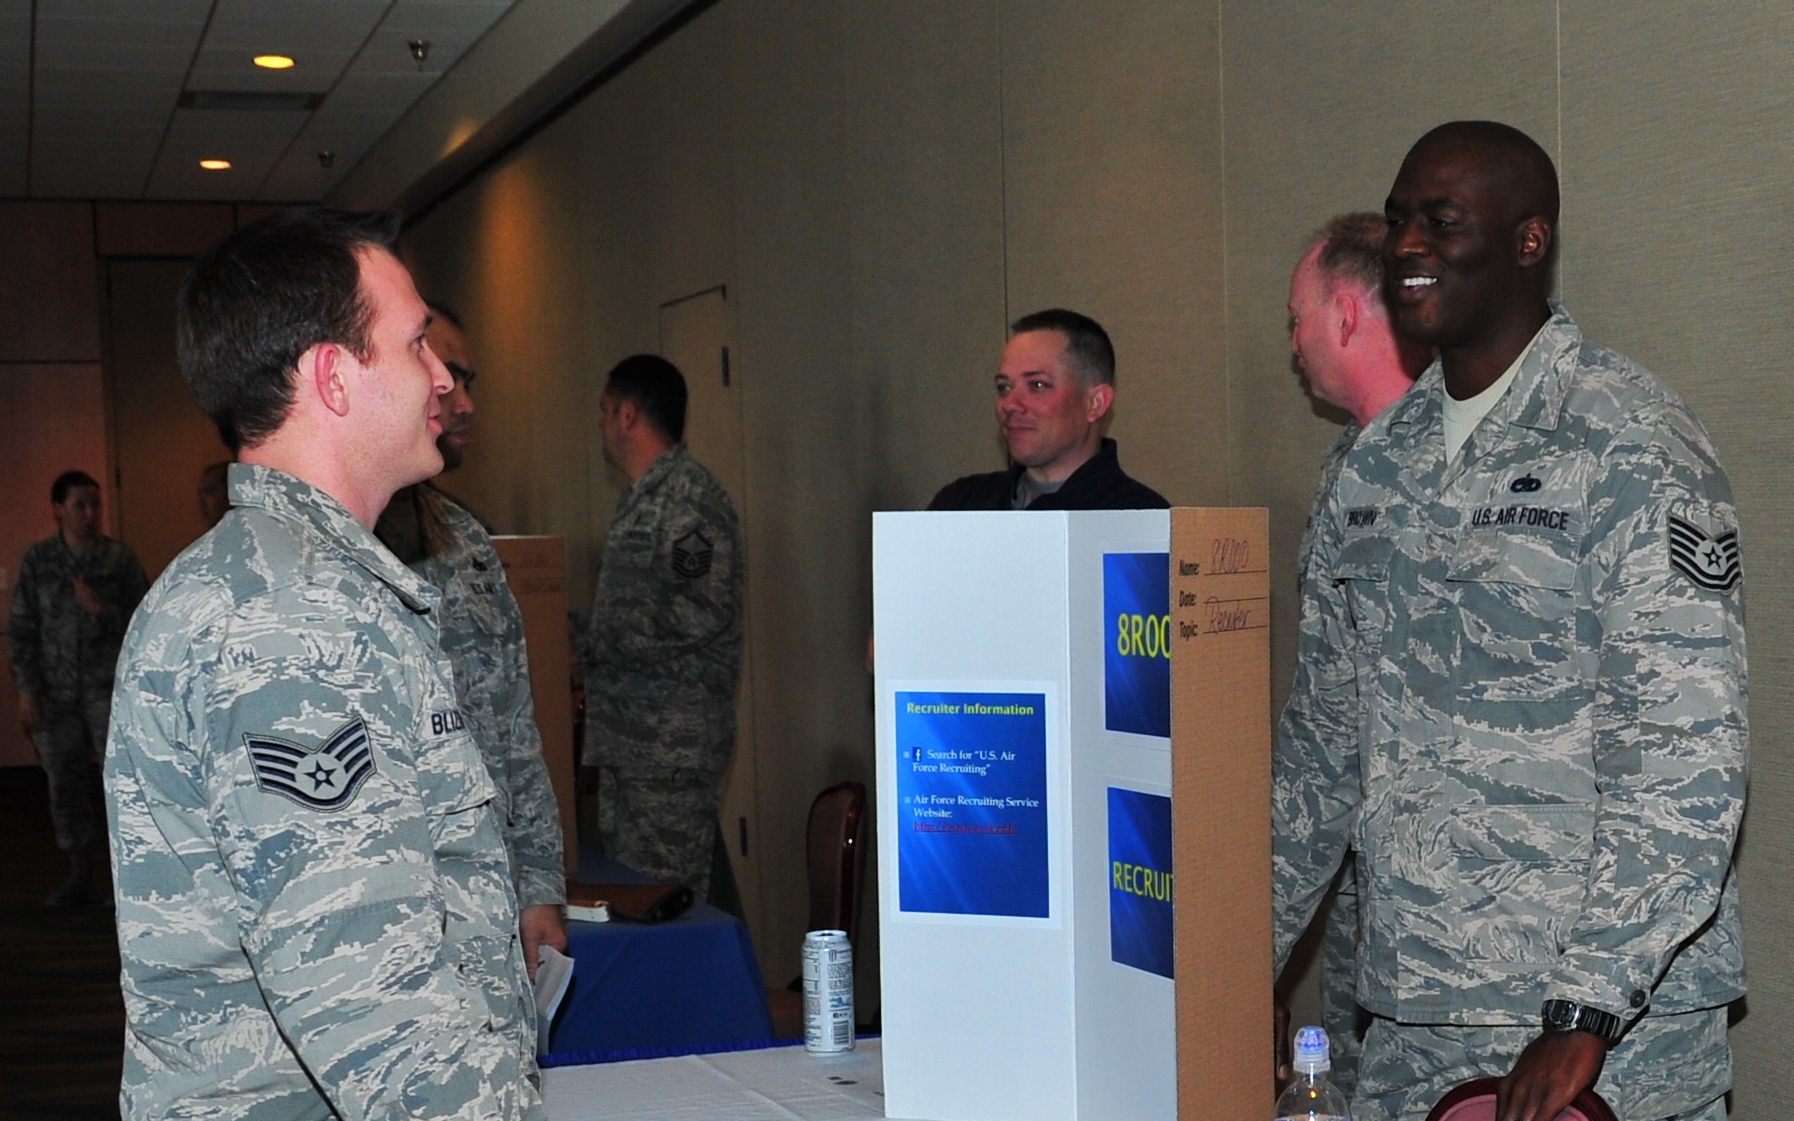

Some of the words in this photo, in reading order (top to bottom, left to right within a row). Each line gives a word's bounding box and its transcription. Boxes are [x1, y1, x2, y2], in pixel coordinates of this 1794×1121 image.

[1495, 506, 1517, 525] AIR
[1519, 507, 1570, 531] FORCE
[906, 702, 961, 715] Recruiter
[963, 702, 1035, 716] Information
[926, 750, 957, 760] Search
[959, 750, 973, 760] for
[1000, 751, 1016, 761] Air
[912, 763, 938, 773] Force
[913, 795, 929, 805] Air
[930, 795, 956, 805] Force
[957, 796, 1005, 809] Recruiting
[1006, 797, 1039, 808] Service
[913, 808, 953, 818] Website:
[1113, 861, 1173, 902] RECRUI
